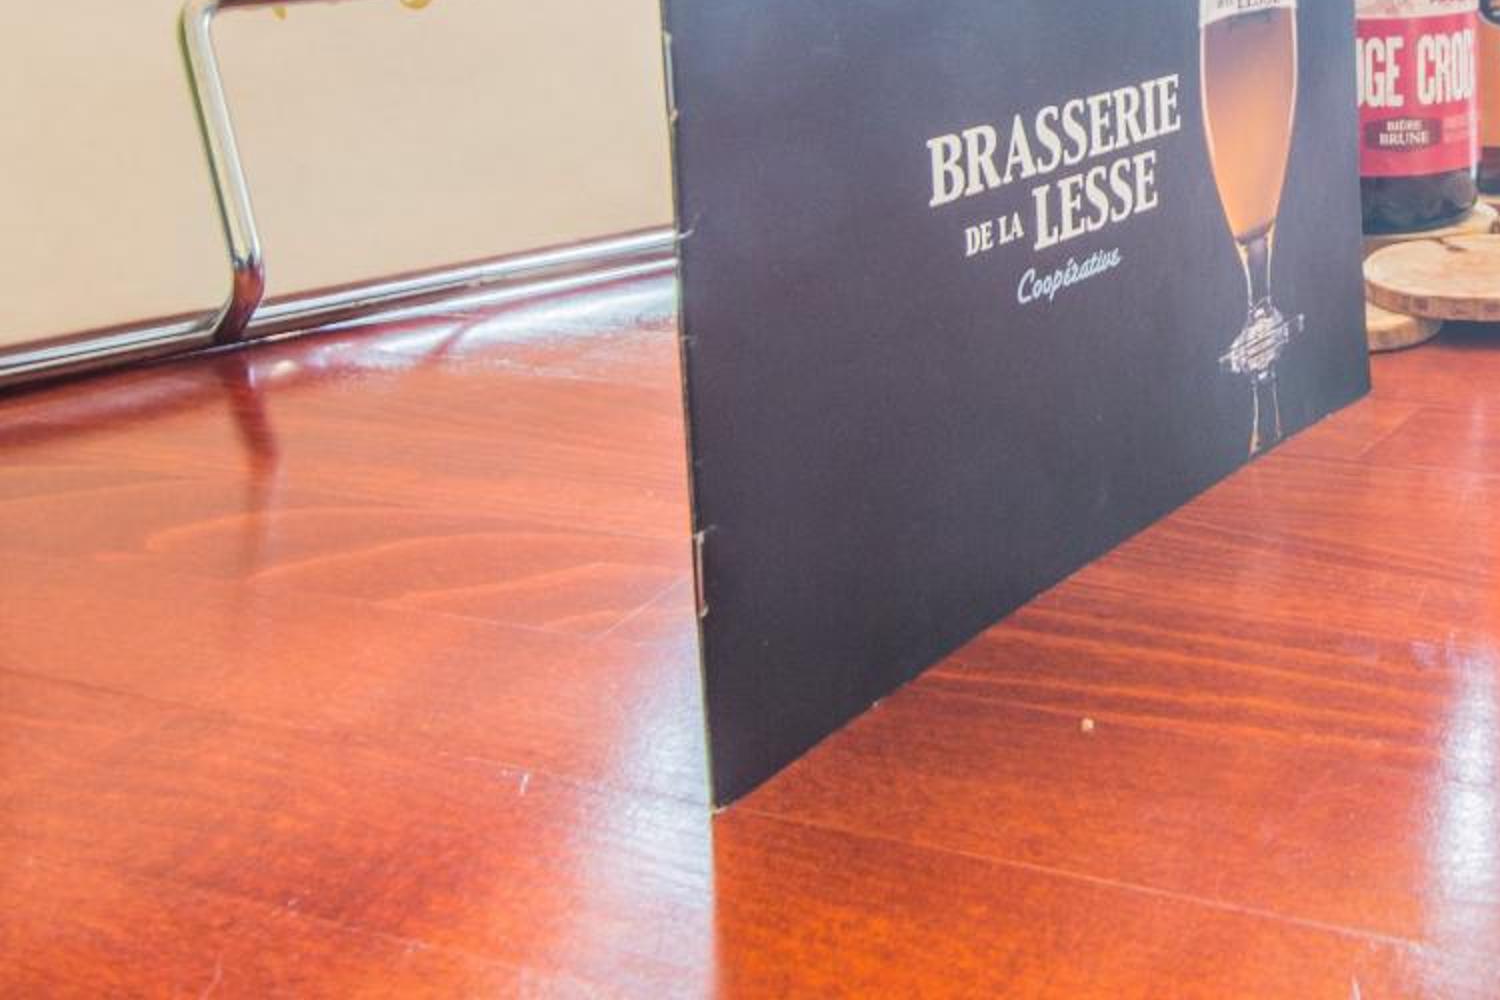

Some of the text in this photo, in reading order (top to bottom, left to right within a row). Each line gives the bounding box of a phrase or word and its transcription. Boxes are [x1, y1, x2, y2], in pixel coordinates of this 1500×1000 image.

[926, 73, 1181, 208] BRASSERIE
[1379, 131, 1429, 146] BRUNE
[964, 149, 1159, 257] DE LA LESSE
[1016, 247, 1122, 304] Coopérative
